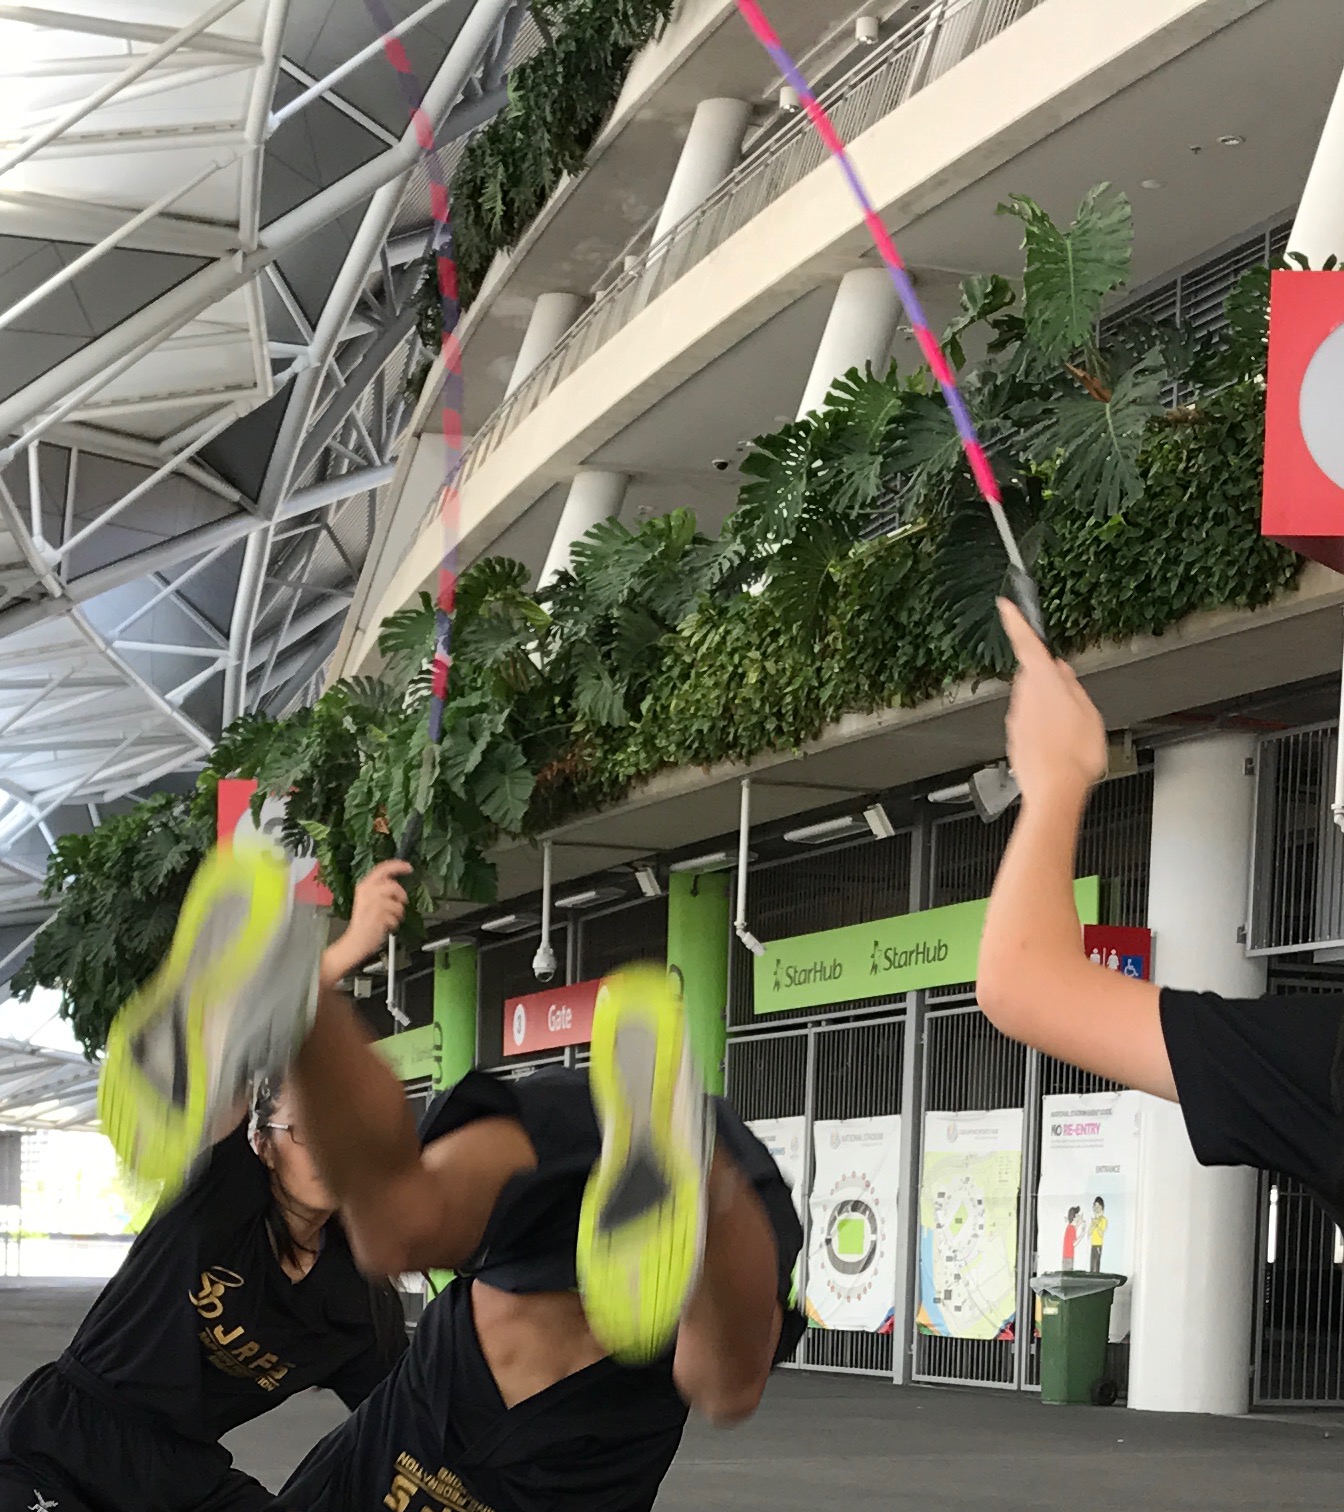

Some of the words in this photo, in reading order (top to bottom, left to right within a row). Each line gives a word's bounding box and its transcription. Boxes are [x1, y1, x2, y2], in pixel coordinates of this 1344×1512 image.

[883, 939, 948, 971] StarHub
[785, 957, 843, 988] StarHub
[547, 1004, 573, 1032] Gate
[1051, 1124, 1062, 1136] NO
[1063, 1122, 1101, 1136] RE-ENTRY
